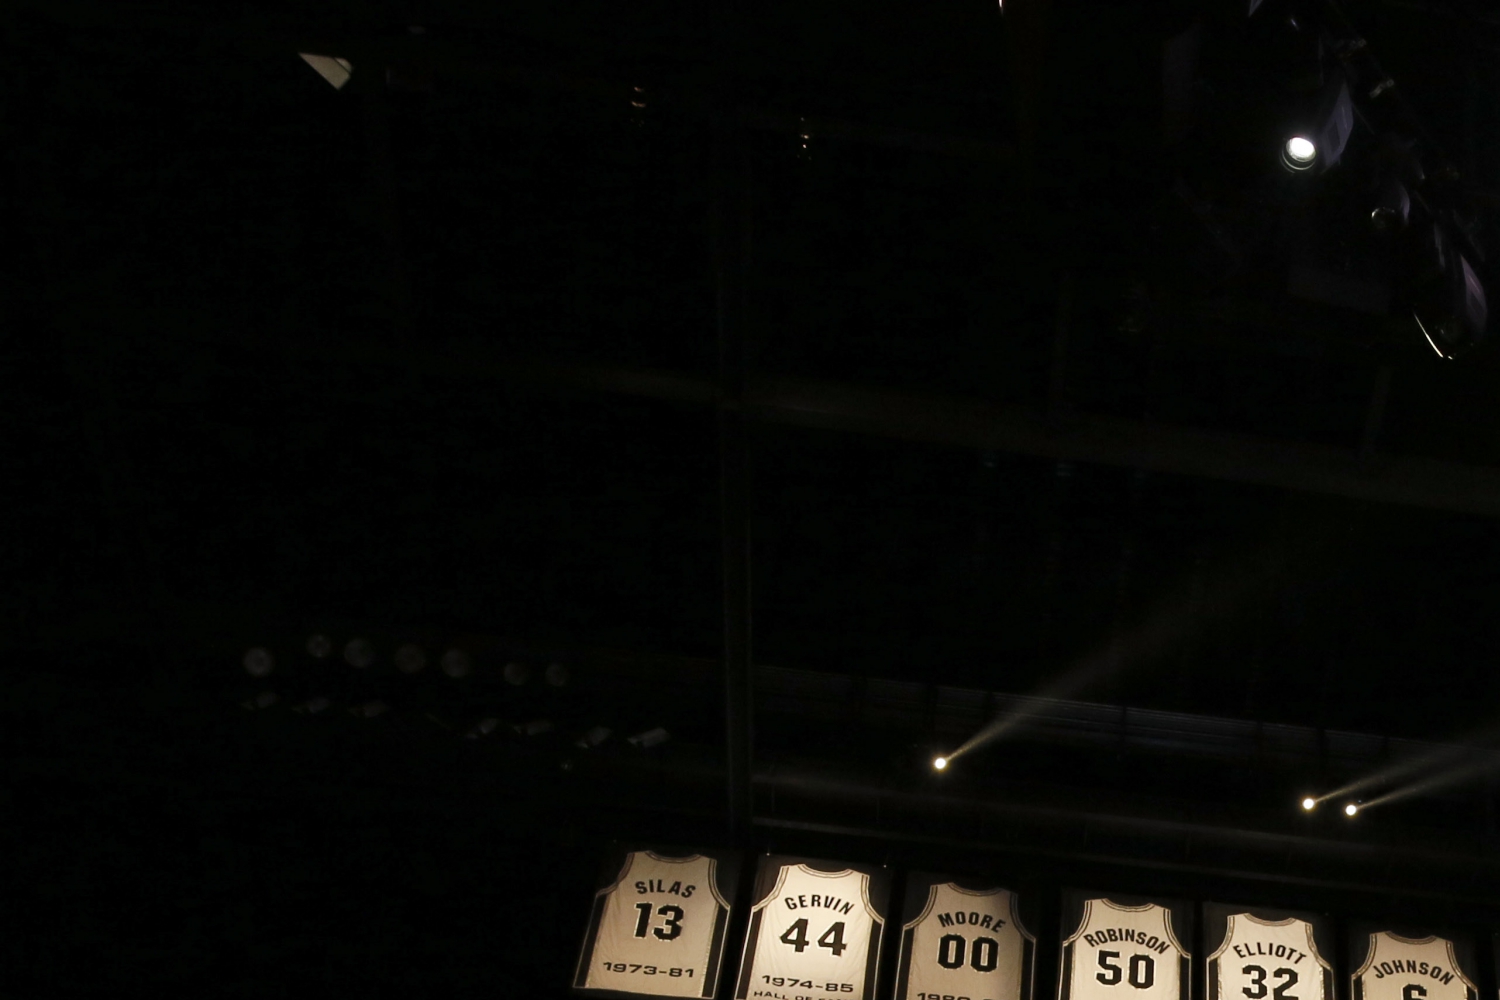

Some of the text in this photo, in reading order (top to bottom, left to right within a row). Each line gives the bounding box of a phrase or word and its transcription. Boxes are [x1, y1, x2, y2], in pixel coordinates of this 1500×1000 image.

[635, 879, 696, 898] SILAS
[784, 894, 855, 916] GERVIN
[633, 901, 685, 942] 13
[937, 910, 1007, 934] MOORE
[779, 917, 849, 957] 44
[1082, 928, 1171, 955] ROBINSON
[937, 933, 999, 973] 00
[1233, 942, 1307, 965] ELLIOTT
[602, 961, 695, 978] 1973-81
[1095, 949, 1155, 990] 50
[1373, 959, 1455, 985] JOHNSON
[754, 990, 789, 1000] HALL
[761, 975, 854, 993] 1974-85
